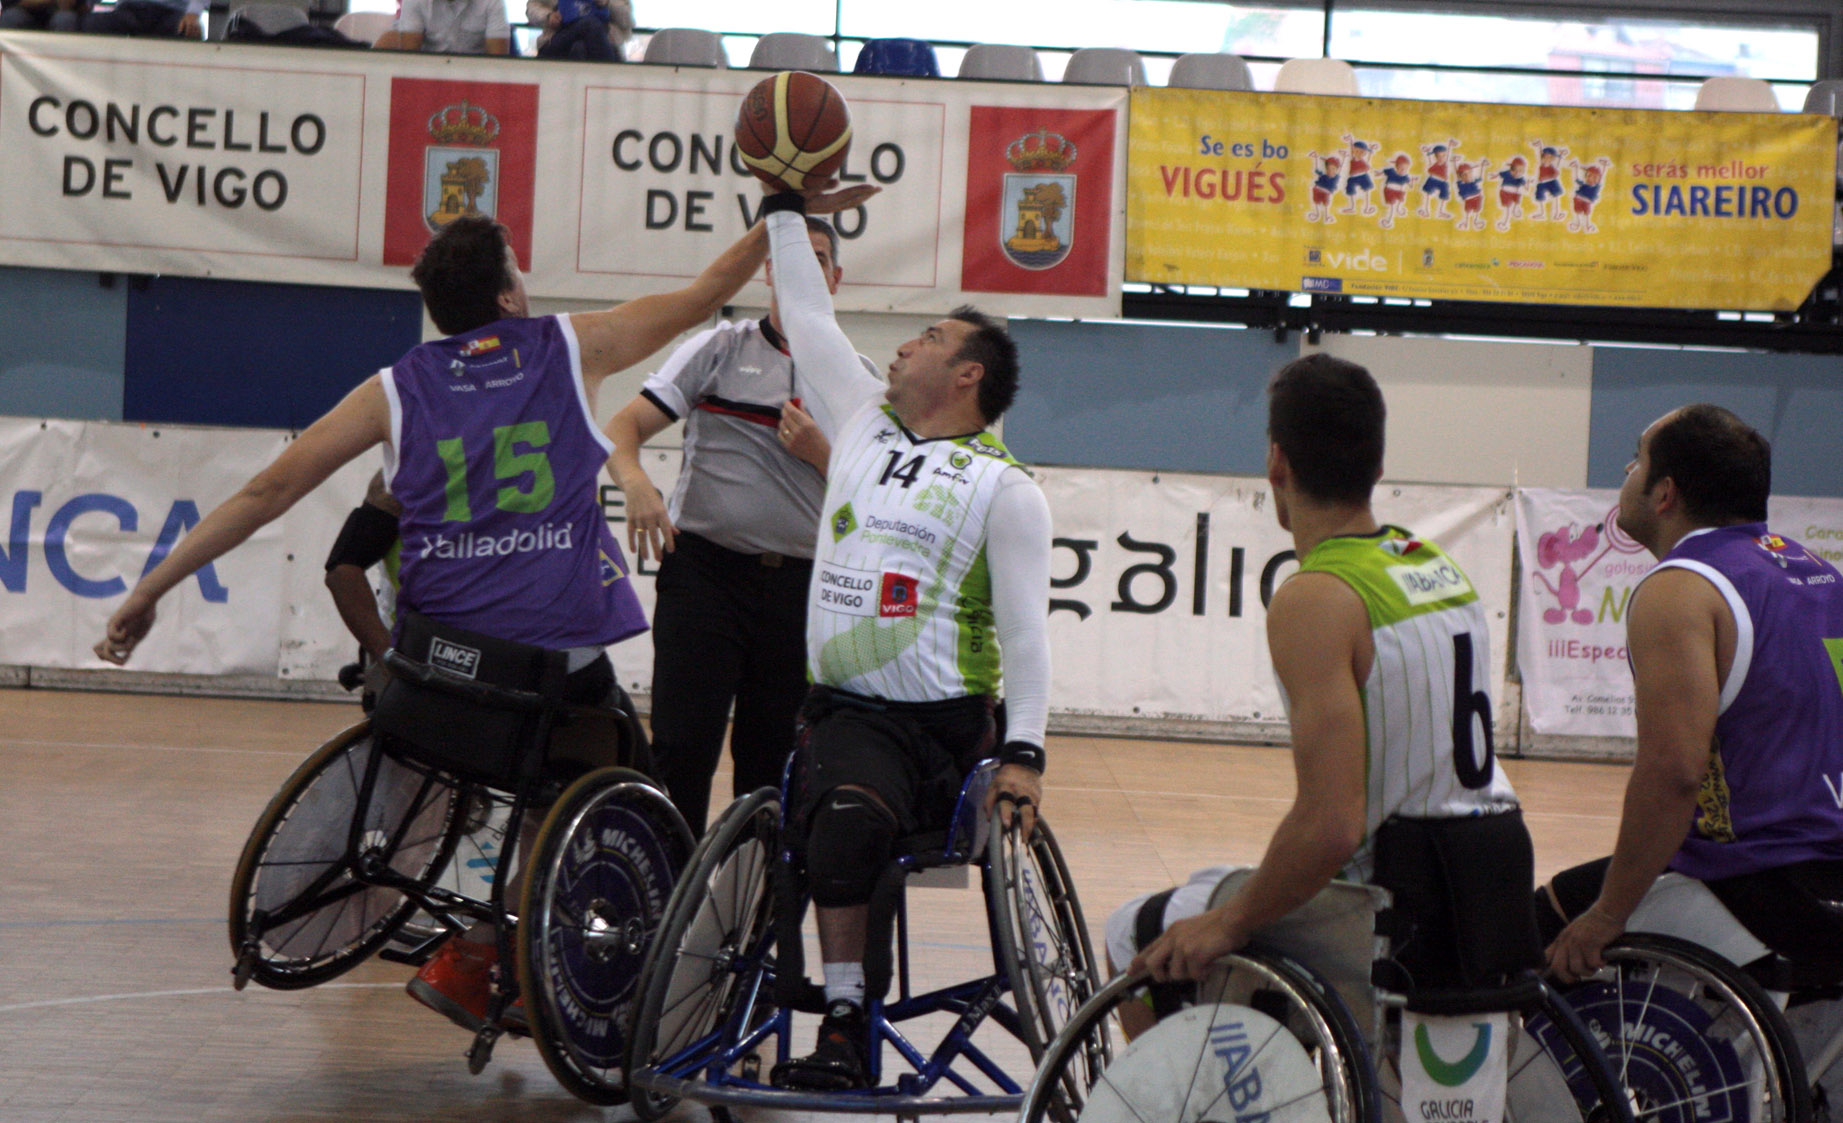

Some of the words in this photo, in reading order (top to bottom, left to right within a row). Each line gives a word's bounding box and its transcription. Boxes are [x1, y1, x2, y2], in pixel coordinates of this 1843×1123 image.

[28, 95, 327, 156] CONCELLO
[612, 129, 906, 184] CONCLO
[1200, 135, 1224, 156] Se
[1232, 142, 1254, 158] es
[1262, 138, 1289, 160] bo
[1160, 162, 1287, 204] VIGUÉS
[1632, 158, 1689, 179] serás
[1697, 161, 1769, 180] mellor
[62, 156, 133, 199] DE
[156, 162, 289, 212] VIGO
[646, 189, 714, 232] DE
[737, 193, 868, 240] VO
[1631, 183, 1799, 220] SIAREIRO
[1326, 248, 1387, 272] vide
[485, 372, 524, 389] ARROYO
[436, 420, 555, 523] 15
[879, 450, 927, 489] 14
[421, 522, 573, 559] Valladolid
[865, 515, 937, 544] Deputación
[861, 530, 931, 558] Pontevedra
[821, 570, 873, 591] CONCELLO
[1807, 574, 1836, 585] ARROYO
[822, 588, 832, 602] DE
[833, 591, 863, 608] VIGO
[882, 604, 915, 613] VIGO
[434, 644, 477, 667] LINCE
[1620, 1022, 1712, 1117] MICHELIN
[1420, 1099, 1474, 1120] GALICIA
